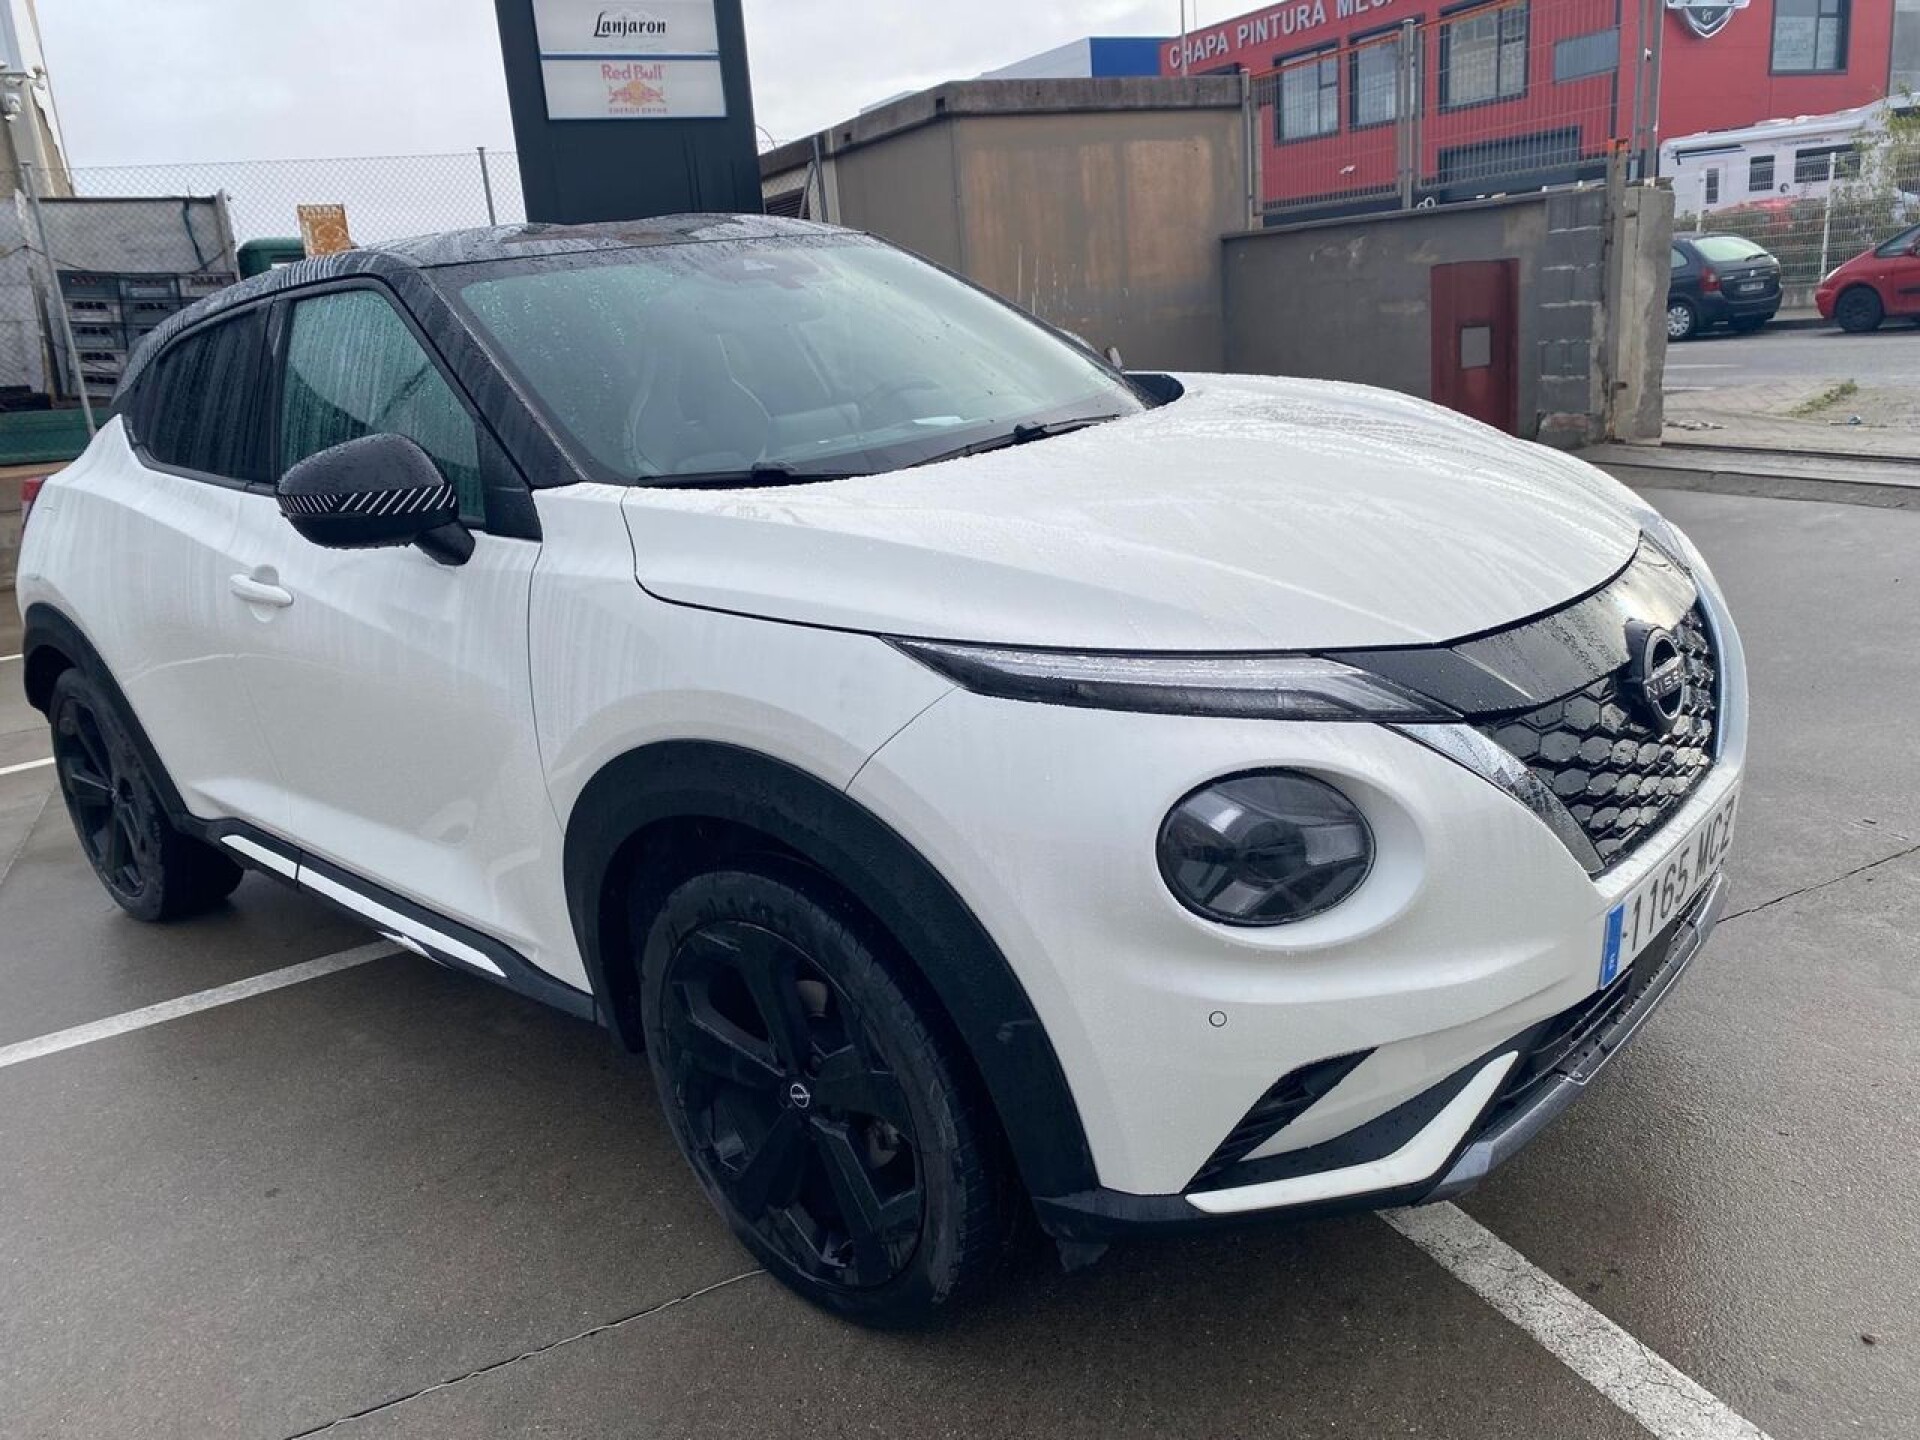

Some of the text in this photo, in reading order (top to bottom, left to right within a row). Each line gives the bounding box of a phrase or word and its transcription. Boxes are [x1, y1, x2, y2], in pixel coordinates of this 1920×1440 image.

[593, 11, 667, 37] Lanjaron
[1169, 34, 1230, 69] CHAPA
[1237, 0, 1327, 49] PINTURA
[602, 64, 663, 80] Red Bull
[1632, 847, 1690, 951] 1165
